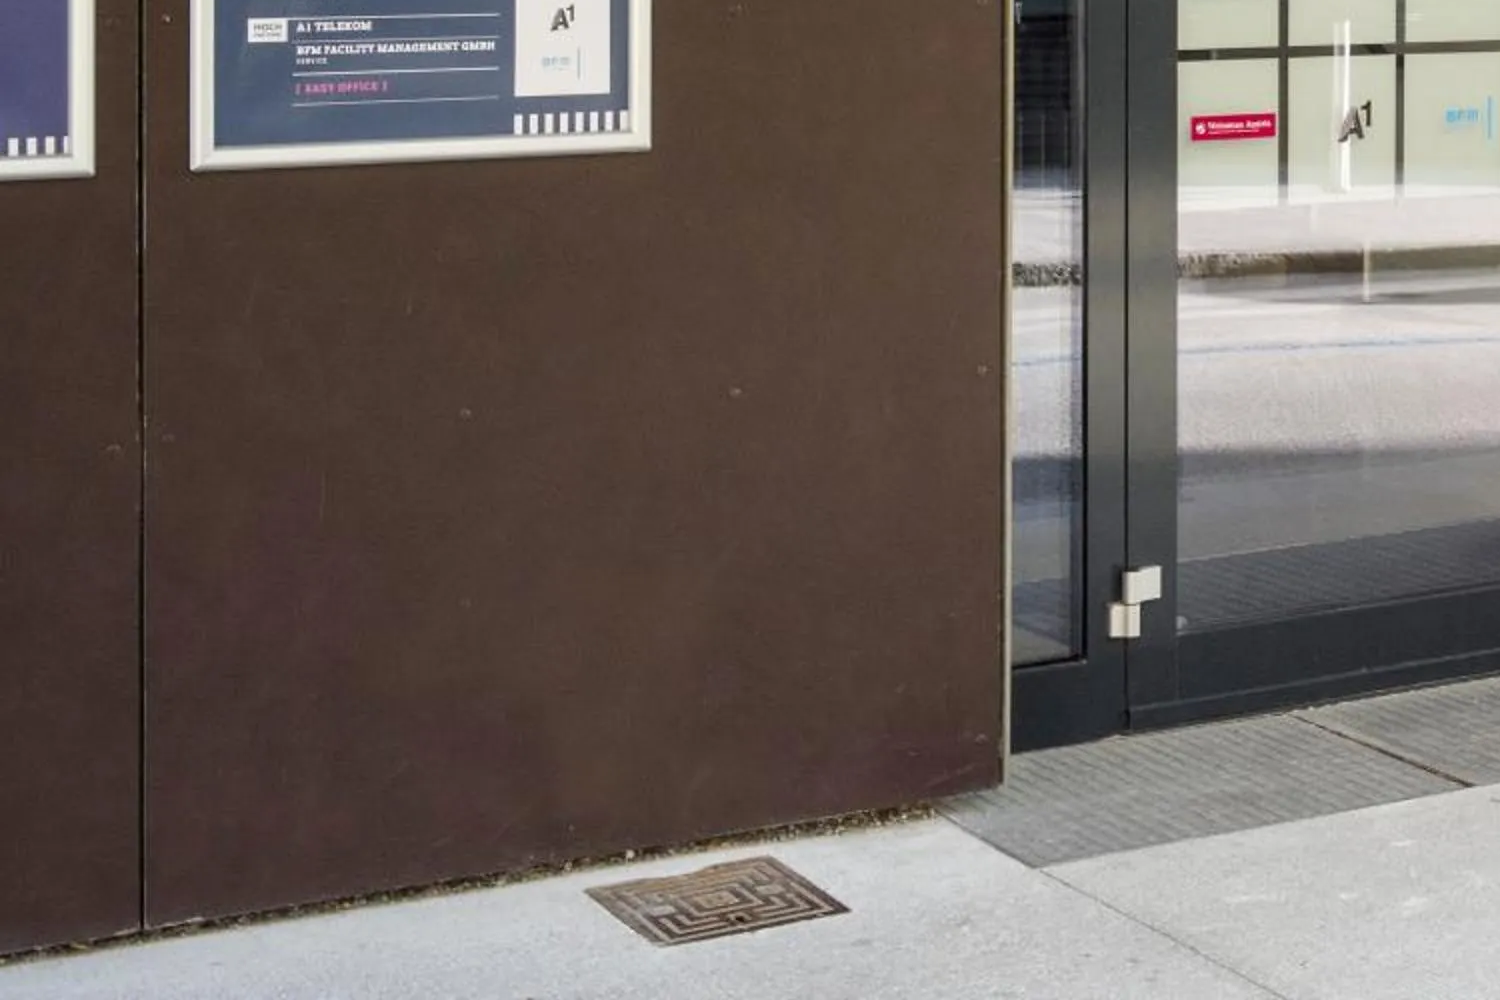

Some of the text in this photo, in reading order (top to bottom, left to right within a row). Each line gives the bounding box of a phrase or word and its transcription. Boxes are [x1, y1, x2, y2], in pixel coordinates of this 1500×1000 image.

[314, 20, 373, 32] TELEKOM
[550, 3, 576, 32] A1
[324, 43, 375, 54] FACILITY
[377, 41, 460, 53] MANAGEMENT
[1338, 100, 1373, 143] A1
